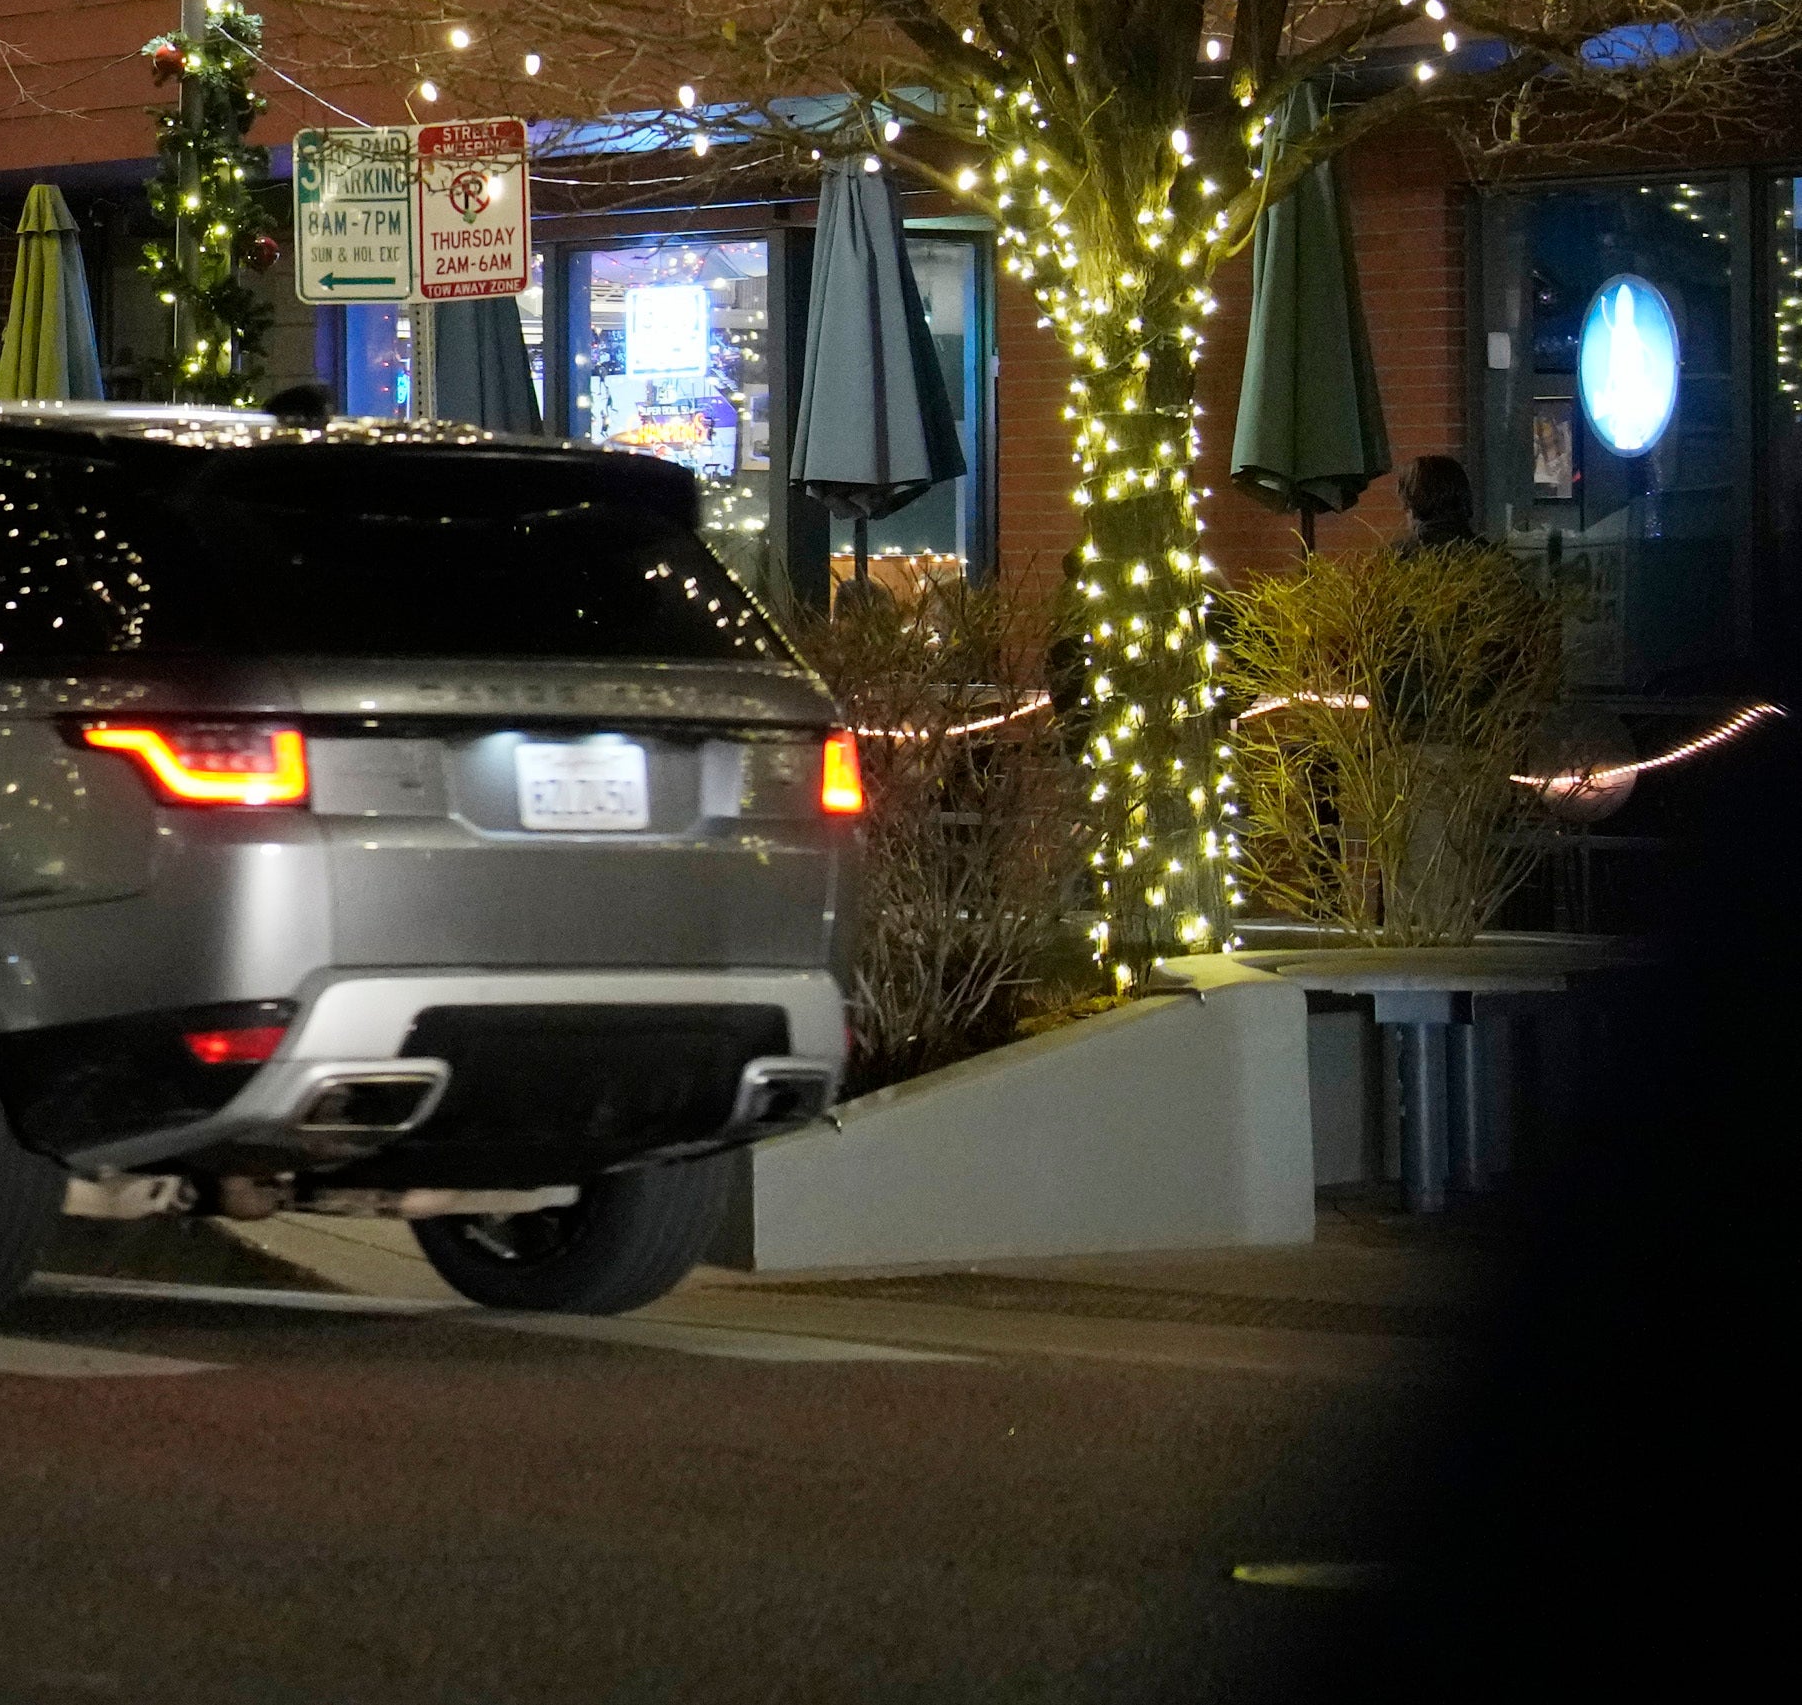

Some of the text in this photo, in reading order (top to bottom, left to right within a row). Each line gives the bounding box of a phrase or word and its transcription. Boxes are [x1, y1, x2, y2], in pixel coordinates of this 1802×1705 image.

[430, 226, 515, 251] THURSDAY
[311, 246, 400, 263] SUN & HOL EXC
[436, 254, 512, 275] 2AM-6AM
[426, 280, 521, 296] TOW AWAY ZONE
